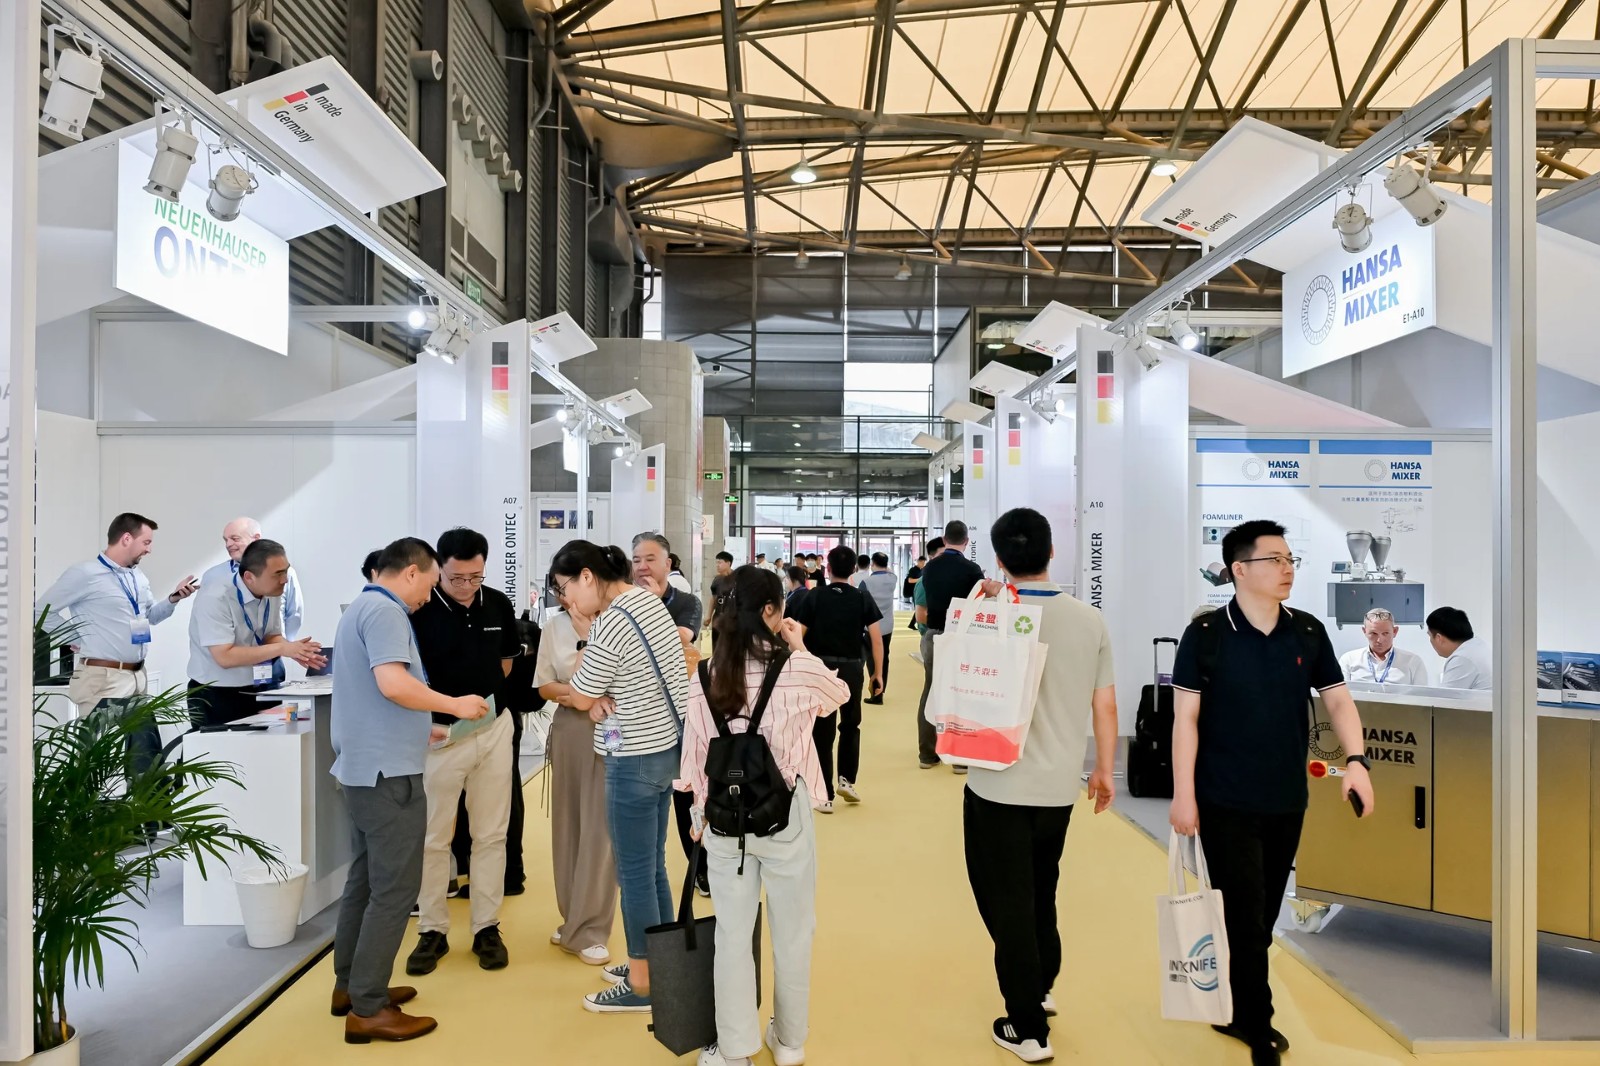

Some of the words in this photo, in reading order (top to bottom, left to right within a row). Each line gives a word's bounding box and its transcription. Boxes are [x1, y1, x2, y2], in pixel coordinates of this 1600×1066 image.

[293, 102, 308, 112] in
[315, 96, 342, 117] made
[274, 110, 314, 142] Germany
[1175, 208, 1194, 221] made
[1204, 212, 1237, 232] Germany
[155, 198, 266, 268] NEUENHAUSER
[1342, 244, 1402, 294] HANSA
[1344, 281, 1399, 327] MIXER
[1403, 307, 1425, 324] E1-A10
[1268, 460, 1300, 469] HANSA
[1390, 461, 1422, 470] HANSA
[1269, 470, 1299, 479] MIXER
[1391, 472, 1421, 480] MIXER
[1089, 501, 1104, 509] A10
[1202, 513, 1243, 521] FOAMLINER
[505, 513, 517, 548] ONTEC
[1091, 532, 1102, 571] MIXER
[1091, 575, 1102, 611] ANSA
[1364, 746, 1415, 765] MIXER
